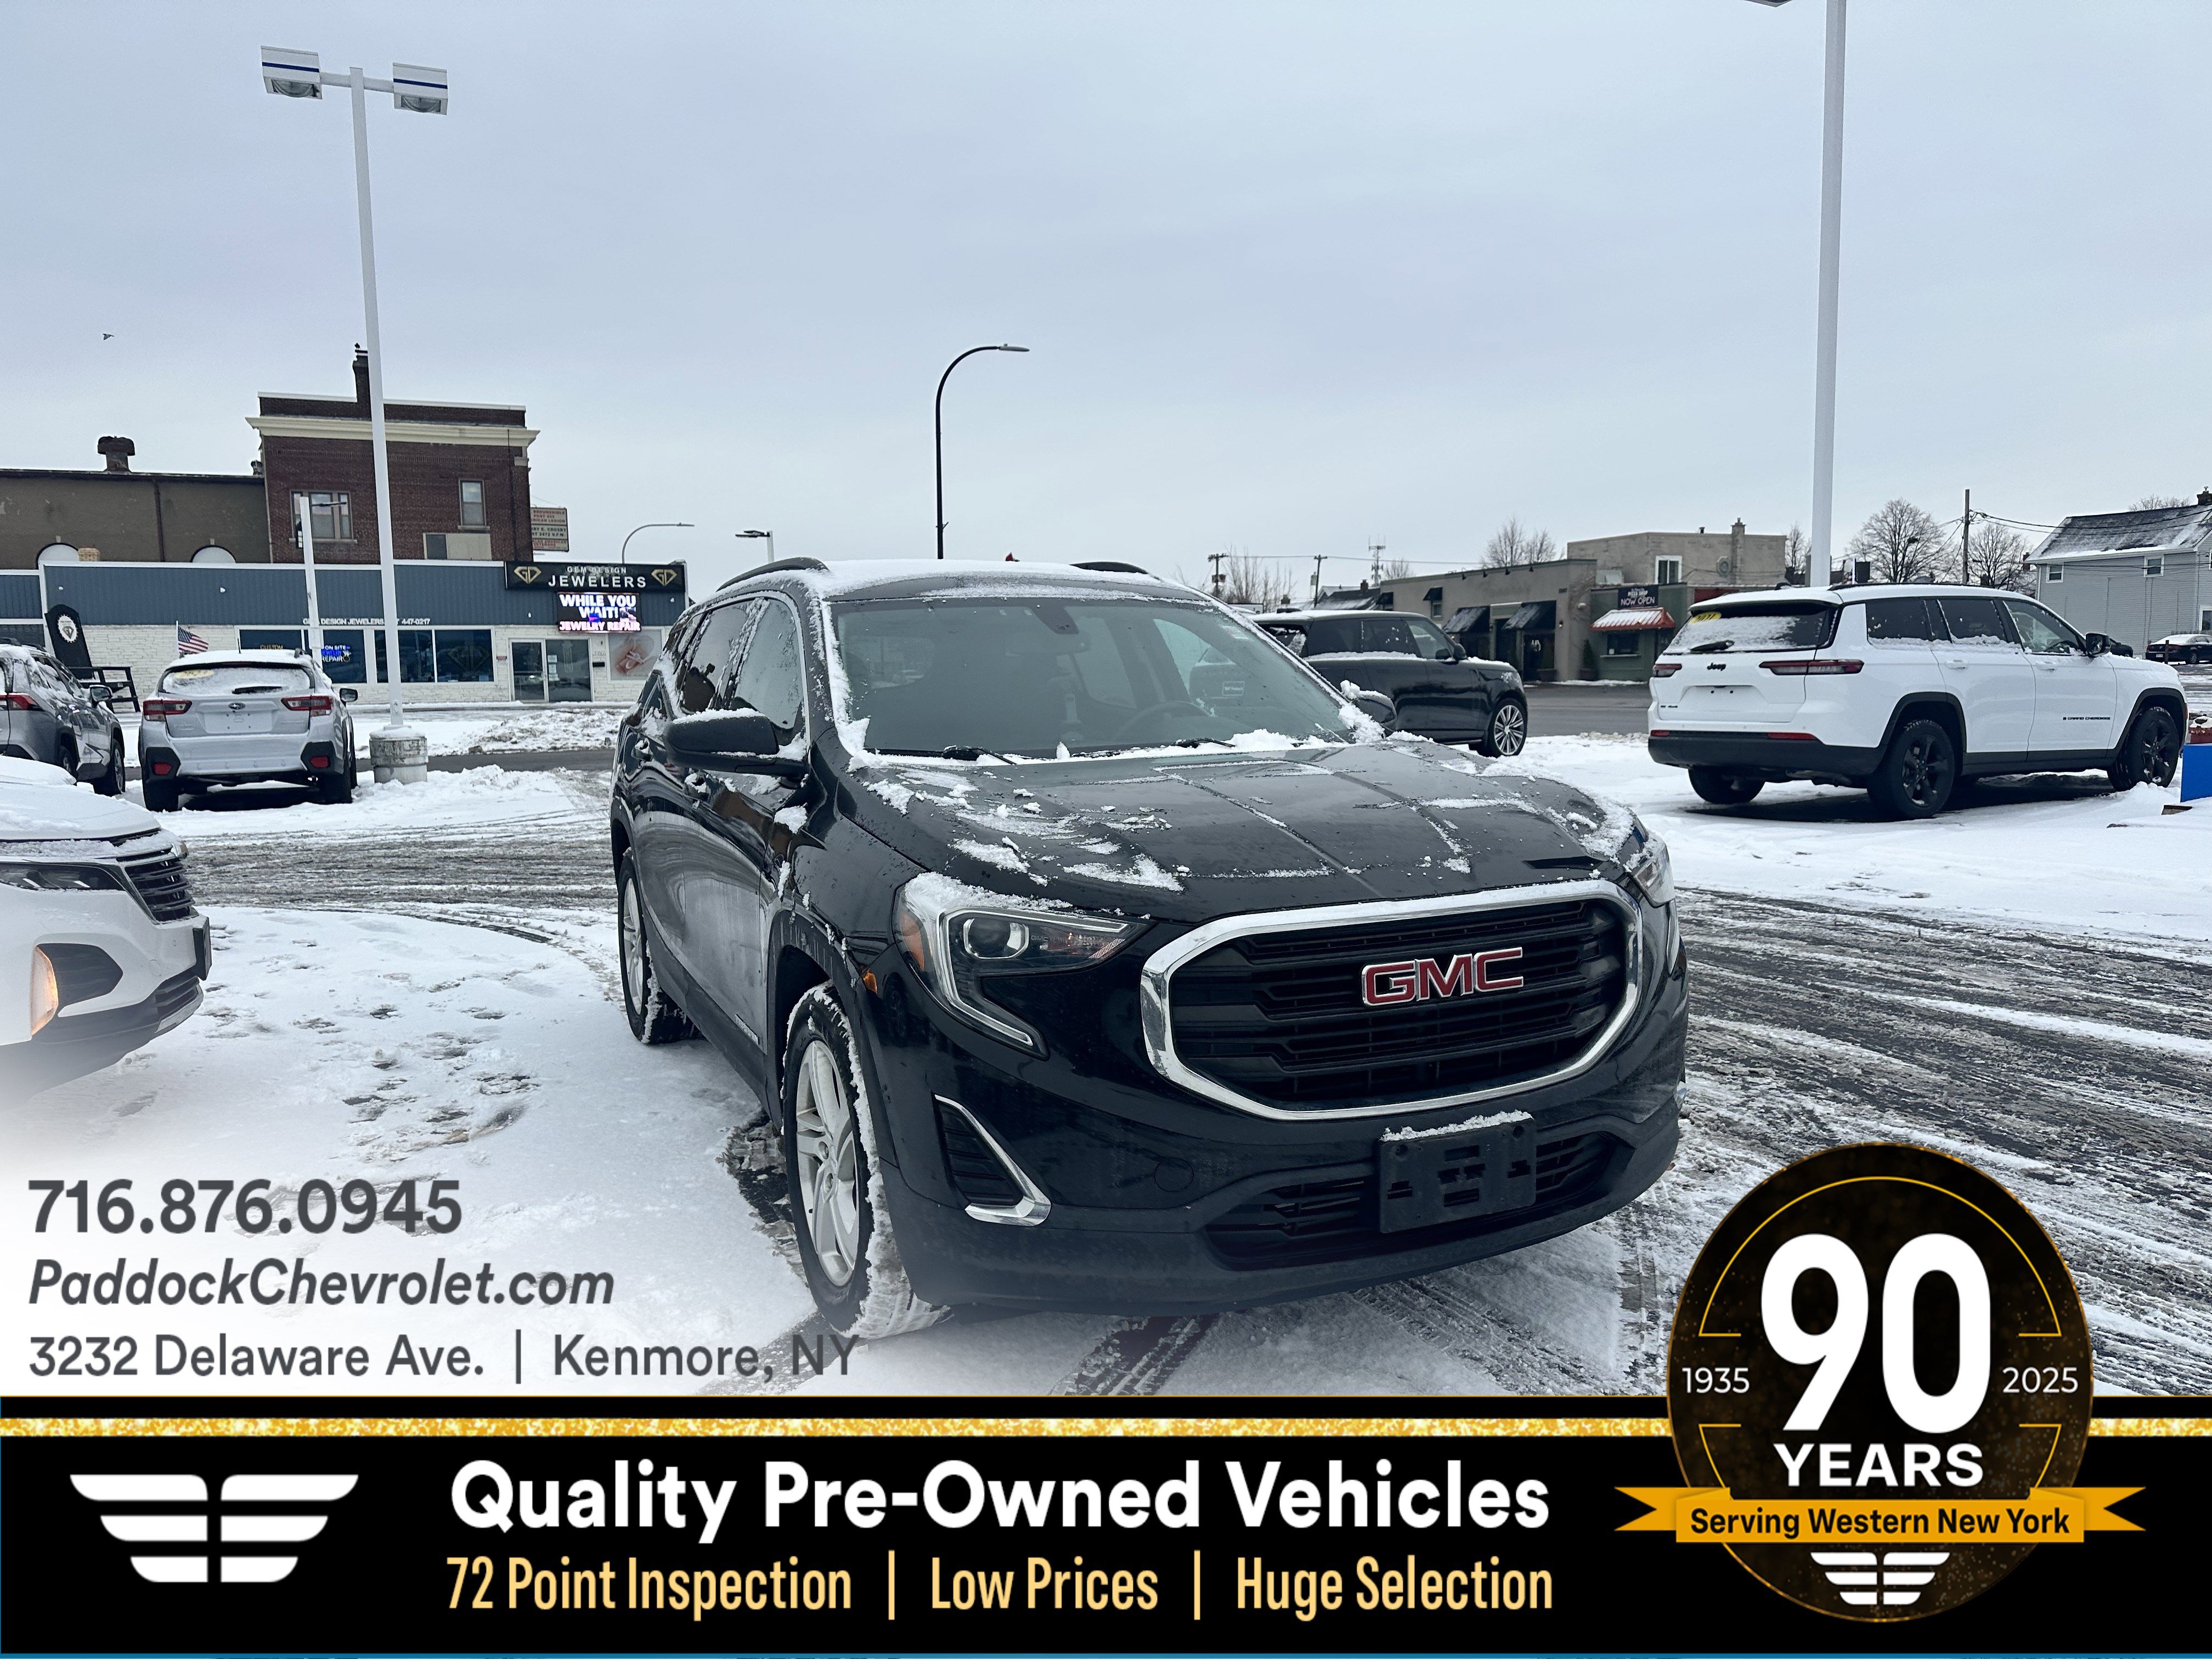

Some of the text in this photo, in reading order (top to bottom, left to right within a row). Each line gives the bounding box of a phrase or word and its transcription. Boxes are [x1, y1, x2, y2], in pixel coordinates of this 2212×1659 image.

[549, 575, 646, 588] JEWELERS
[559, 594, 636, 607] WHILE YOU
[1638, 596, 1655, 605] OPEN
[579, 606, 619, 619] WAIT!
[559, 621, 641, 631] JEWELRY REPAIR
[1707, 662, 1726, 671] Jeep
[1362, 947, 1523, 1006] GMC
